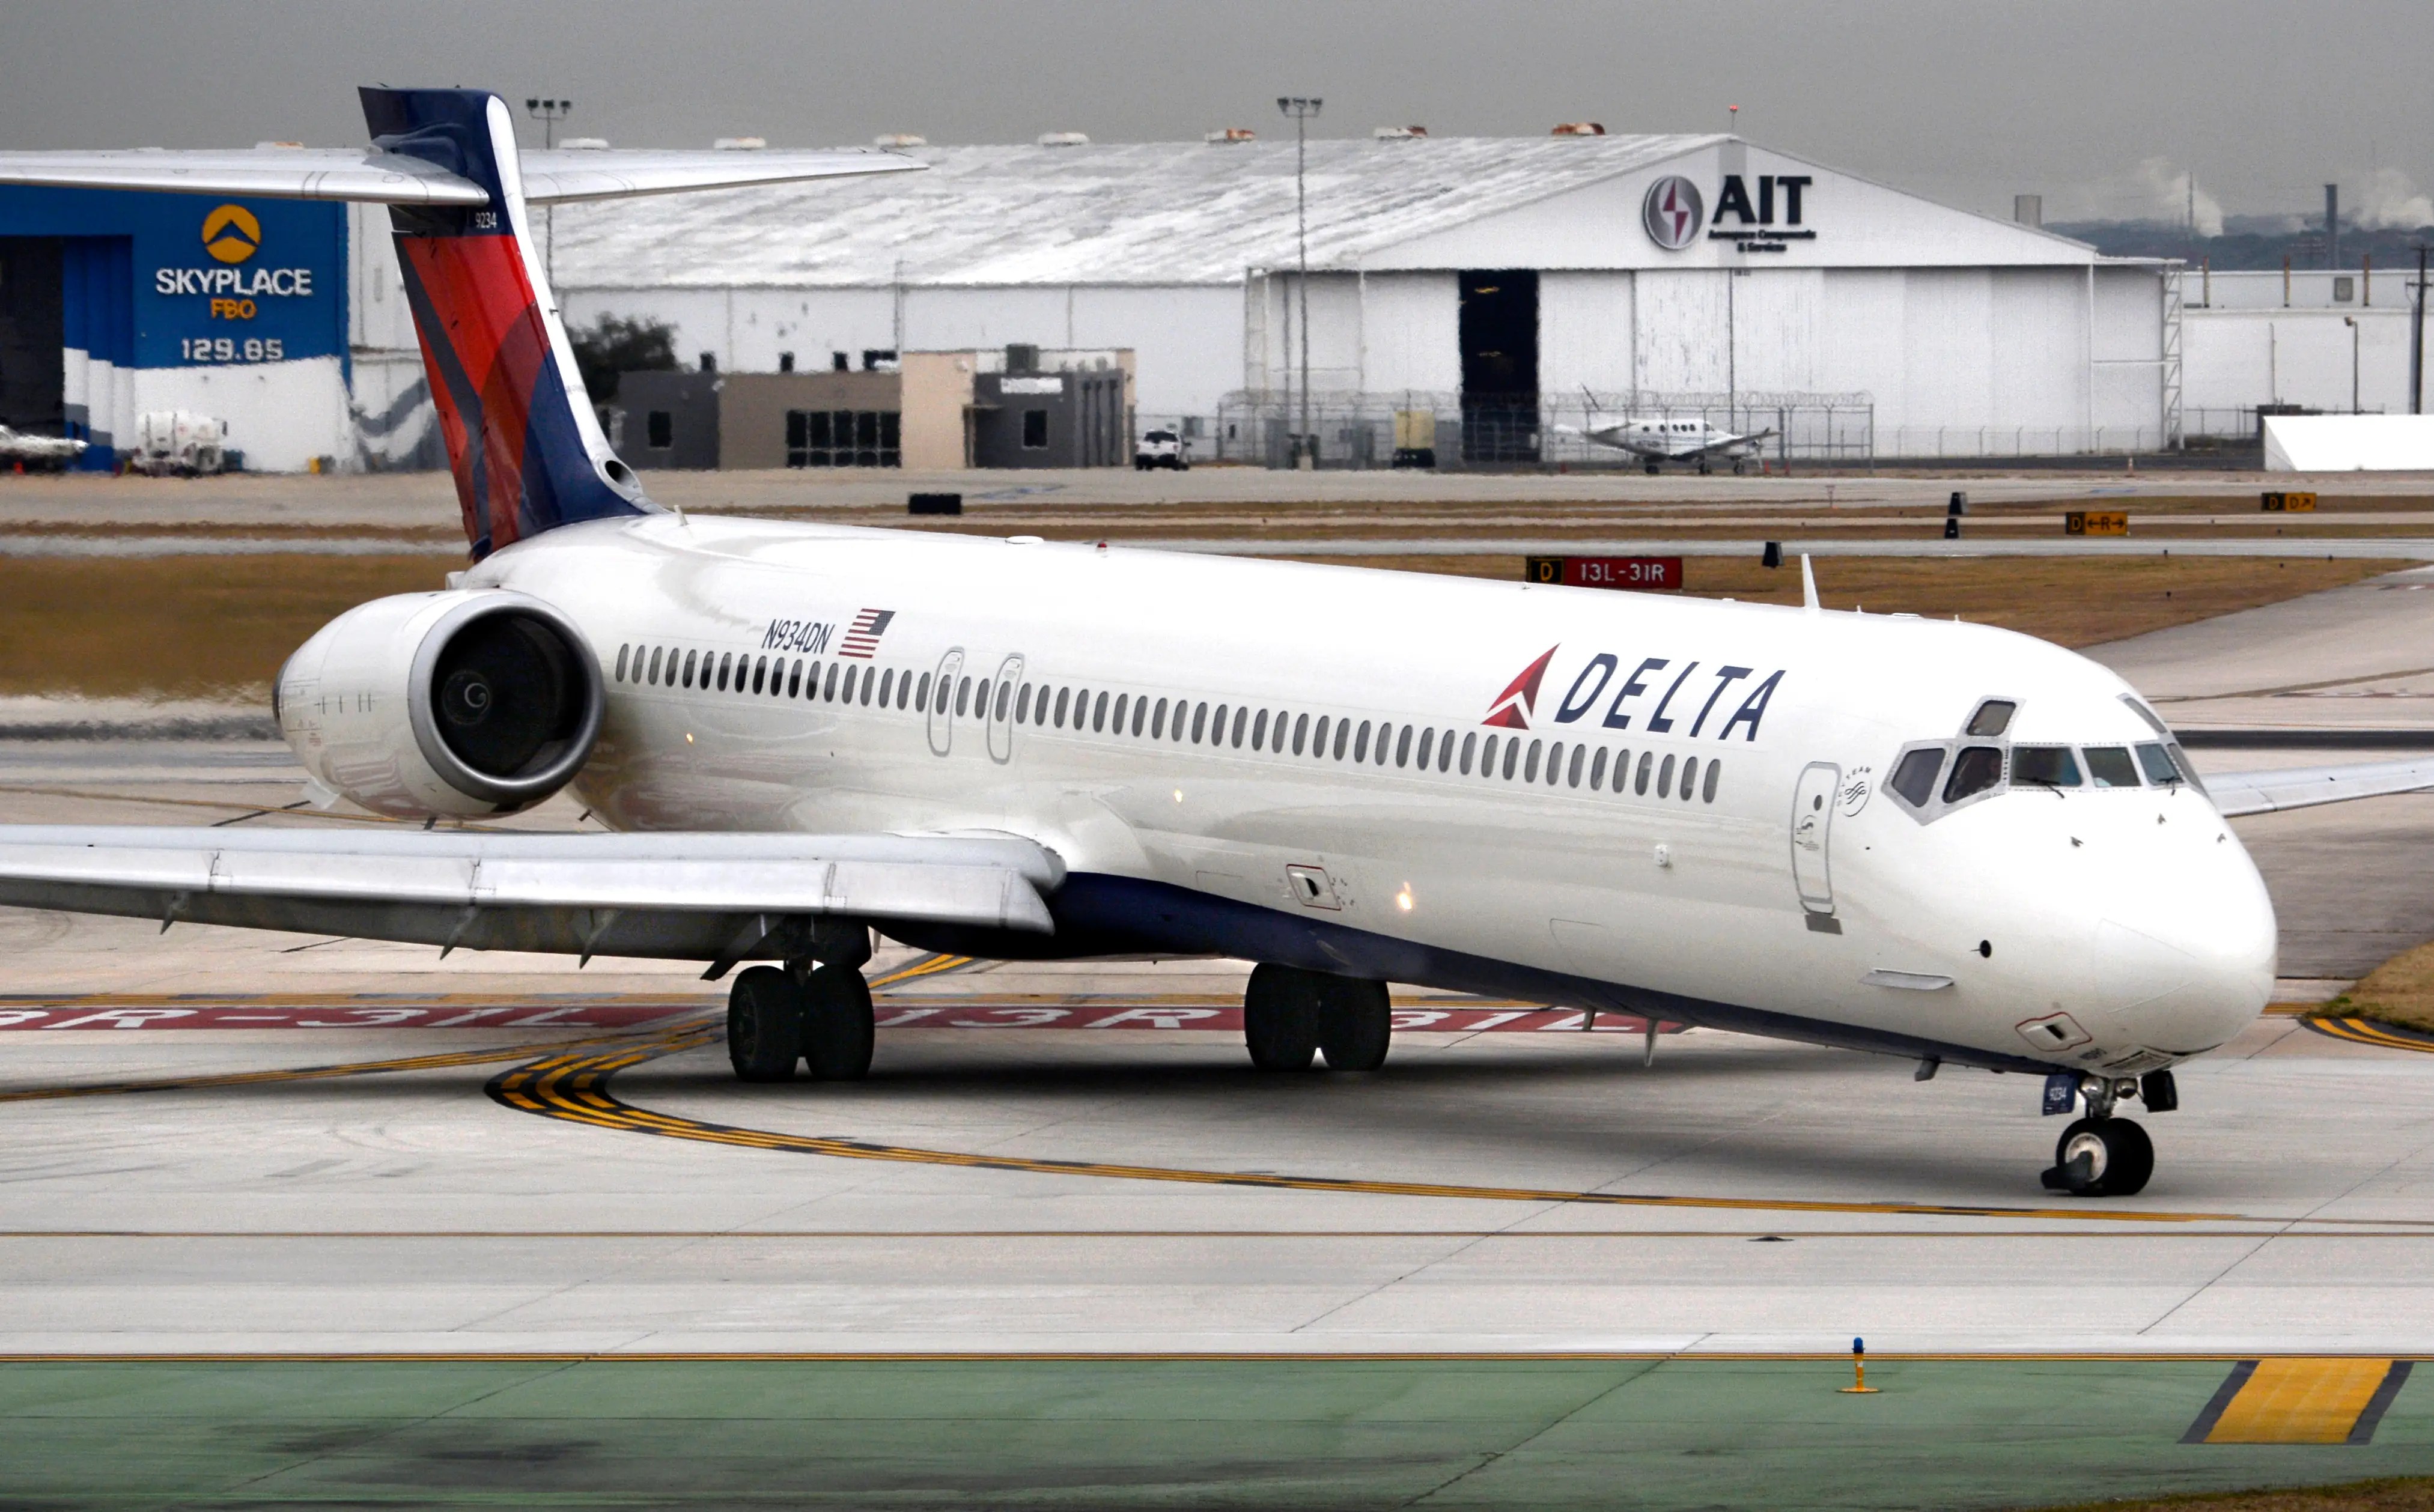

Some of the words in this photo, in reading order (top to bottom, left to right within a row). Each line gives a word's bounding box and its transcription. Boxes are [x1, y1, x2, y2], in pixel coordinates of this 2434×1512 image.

[1712, 175, 1812, 225] AIT
[475, 211, 498, 228] 9234
[156, 268, 313, 296] SKYPLACE
[210, 297, 257, 320] FBO
[181, 338, 284, 360] 129.85
[2071, 517, 2081, 530] D
[2101, 516, 2111, 530] R
[1540, 562, 1553, 581] D
[1580, 563, 1665, 581] 13L-31R
[761, 619, 836, 654] N934DN
[1554, 653, 1786, 742] DELTA
